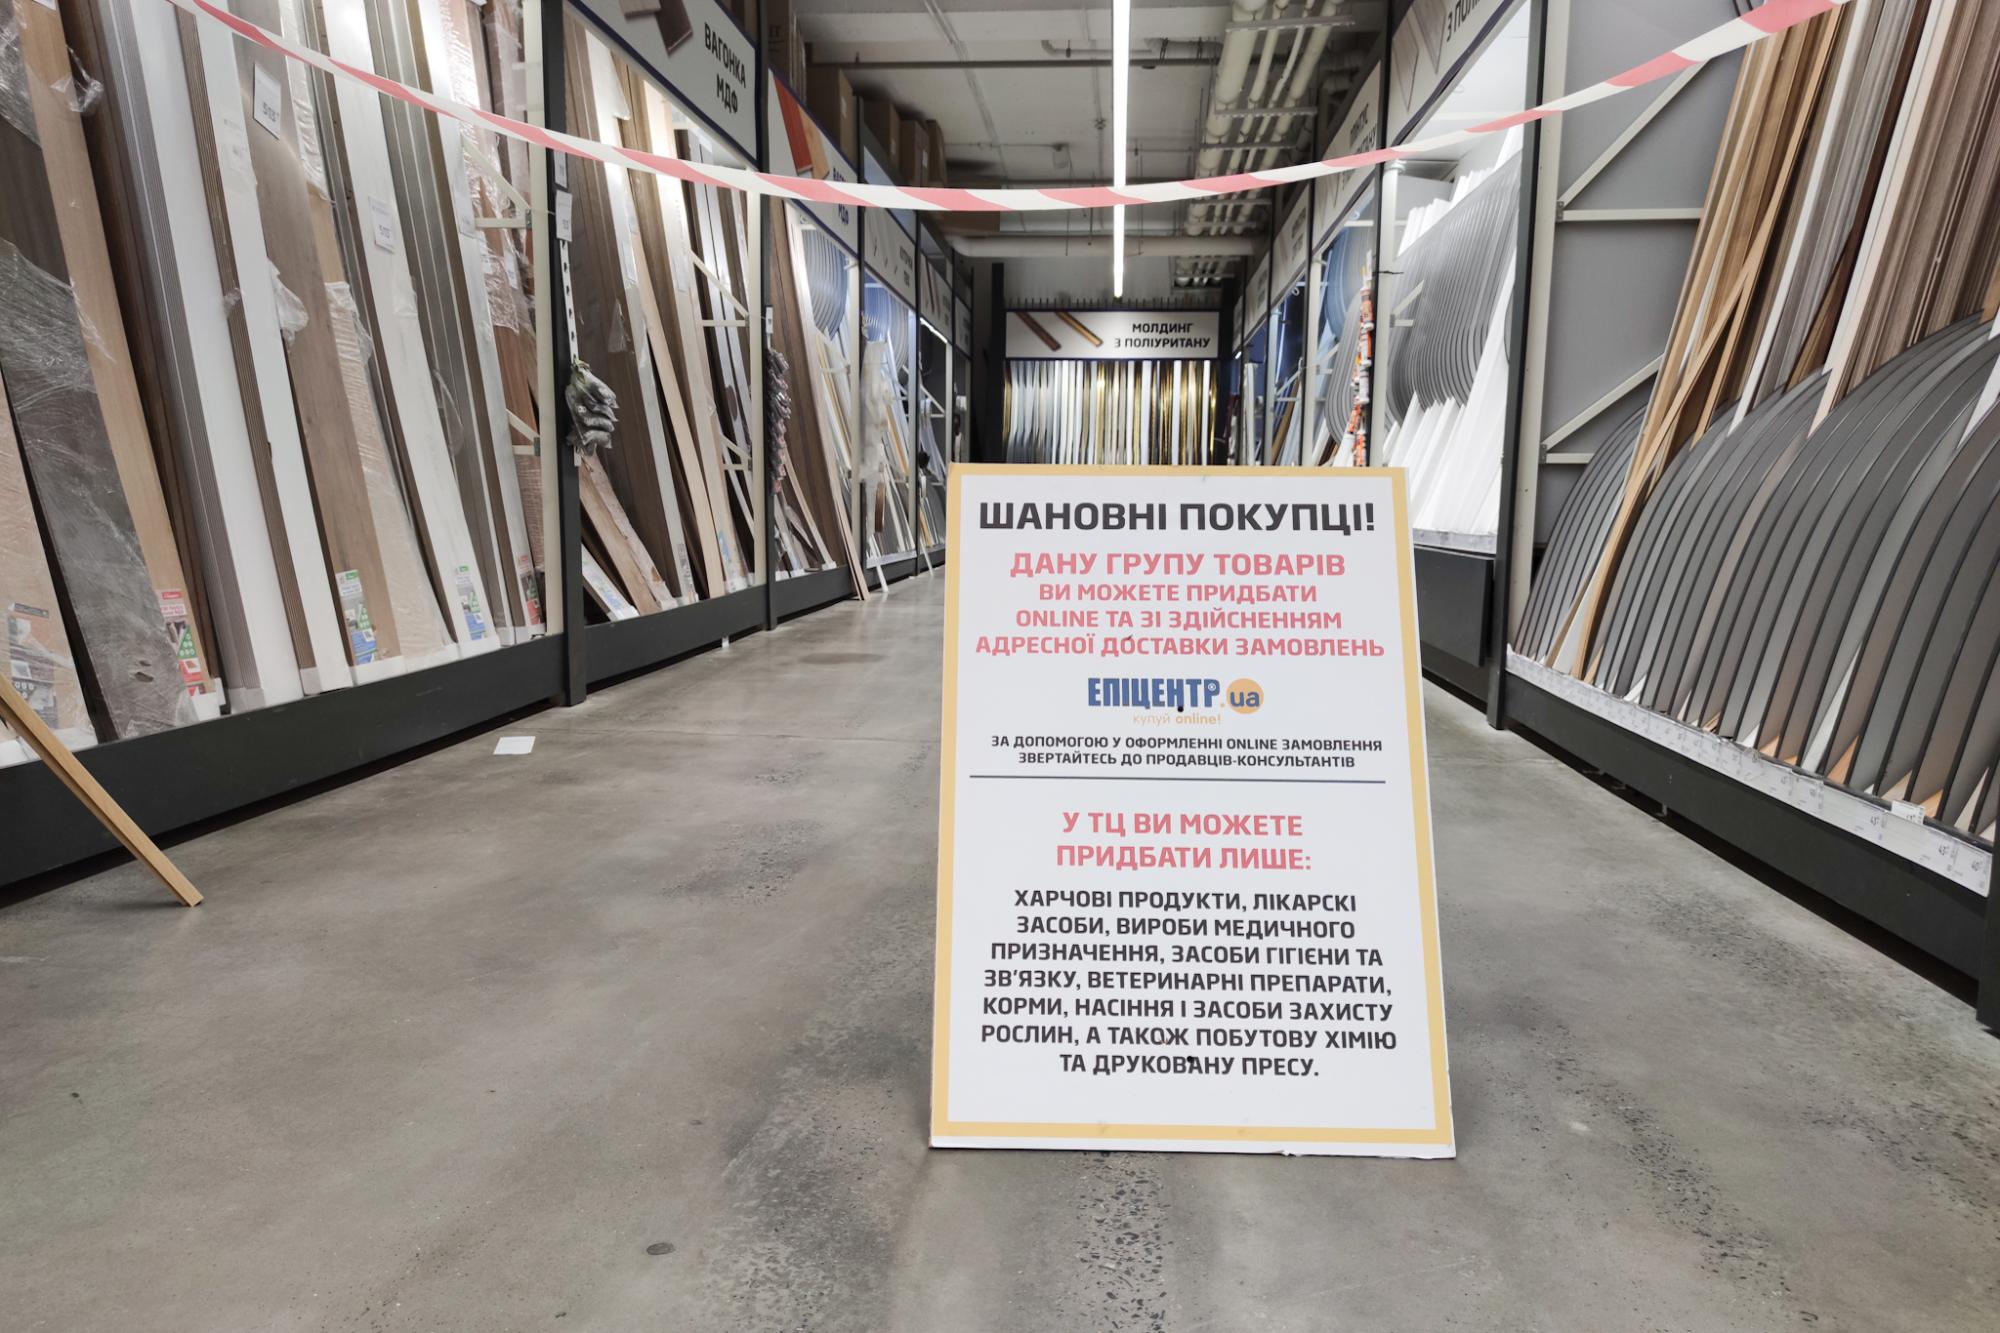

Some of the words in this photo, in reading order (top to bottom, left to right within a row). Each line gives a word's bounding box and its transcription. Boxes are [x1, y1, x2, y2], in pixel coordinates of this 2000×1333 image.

[1446, 11, 1453, 42] З
[704, 22, 746, 88] ВАГОНКА
[716, 74, 738, 114] МДФ
[1132, 323, 1194, 334] МОЛДИНГ
[1115, 338, 1121, 348] З
[1125, 338, 1211, 348] ПОЛІУРИТАНУ
[979, 501, 1167, 531] ШАНОВНІ
[1179, 502, 1375, 536] ПОКУПЦІ!
[1010, 552, 1098, 578] ДАНУ
[1106, 553, 1205, 576] ГРУПУ
[1213, 553, 1345, 576] ТОВАРІВ
[1039, 583, 1071, 601] ВИ
[1077, 583, 1180, 602] МОЖЕТЕ
[1186, 584, 1317, 605] ПРИДБАТИ
[1016, 609, 1099, 628] ONLINE
[1105, 610, 1134, 628] ТА
[1140, 610, 1161, 628] ЗІ
[1168, 607, 1342, 632] ЗДІЙСНЕННЯМ
[975, 633, 1096, 657] АДРЕСНОЇ
[1100, 637, 1228, 658] ДОСТАВКИ
[1235, 637, 1385, 657] ЗАМОВЛЕНЬ
[1132, 714, 1171, 727] купуй
[1175, 713, 1222, 725] online!
[991, 735, 1010, 747] ЗА
[1012, 735, 1109, 749] ДОПОМОГОЮ
[1112, 736, 1122, 749] У
[1125, 736, 1223, 750] ОФОРМЛЕННІ
[1226, 738, 1278, 751] ONLINE
[1281, 738, 1383, 752] ЗАМОВЛЕННЯ
[1018, 750, 1118, 765] ЗВЕРТАЙТЕСЬ
[1120, 753, 1143, 767] ДО
[1145, 753, 1356, 768] ПРОДАВЦІВ-КОНСУЛЬТАНТІВ
[1063, 812, 1080, 833] У
[1087, 812, 1126, 838] ТЦ
[1134, 813, 1172, 834] ВИ
[1180, 813, 1303, 836] МОЖЕТЕ
[1057, 845, 1212, 871] ПРИДБАТИ
[1219, 847, 1311, 870] ЛИШЕ:
[1014, 889, 1112, 908] ХАРЧОВІ
[1118, 891, 1247, 913] ПРОДУКТИ,
[1252, 893, 1357, 913] ЛІКАРСКІ
[1016, 915, 1111, 937] ЗАСОБИ,
[1116, 917, 1208, 937] ВИРОБИ
[1214, 919, 1356, 941] МЕДИЧНОГО
[991, 942, 1165, 965] ПРИЗНАЧЕННЯ,
[1171, 944, 1260, 965] ЗАСОБИ
[1266, 946, 1350, 966] ГІГІЄНИ
[1355, 948, 1384, 967] ТА
[1087, 970, 1244, 992] ВЕТЕРИНАРНІ
[1250, 973, 1392, 997] ПРЕПАРАТИ,
[983, 996, 1069, 1019] КОРМИ,
[1075, 998, 1174, 1018] НАСІННЯ
[1180, 999, 1187, 1018] І
[1193, 999, 1283, 1020] ЗАСОБИ
[1289, 1001, 1393, 1022] ЗАХИСТУ
[981, 1024, 1080, 1047] РОСЛИН,
[1085, 1026, 1102, 1045] А
[1107, 1026, 1190, 1046] ТАКОЖ
[1195, 1028, 1318, 1049] ПОБУТОВУ
[1324, 1030, 1397, 1050] ХІМІЮ
[1058, 1053, 1087, 1073] ТА
[1092, 1054, 1236, 1076] ДРУКОВАНУ
[1241, 1057, 1319, 1077] ПРЕСУ.
